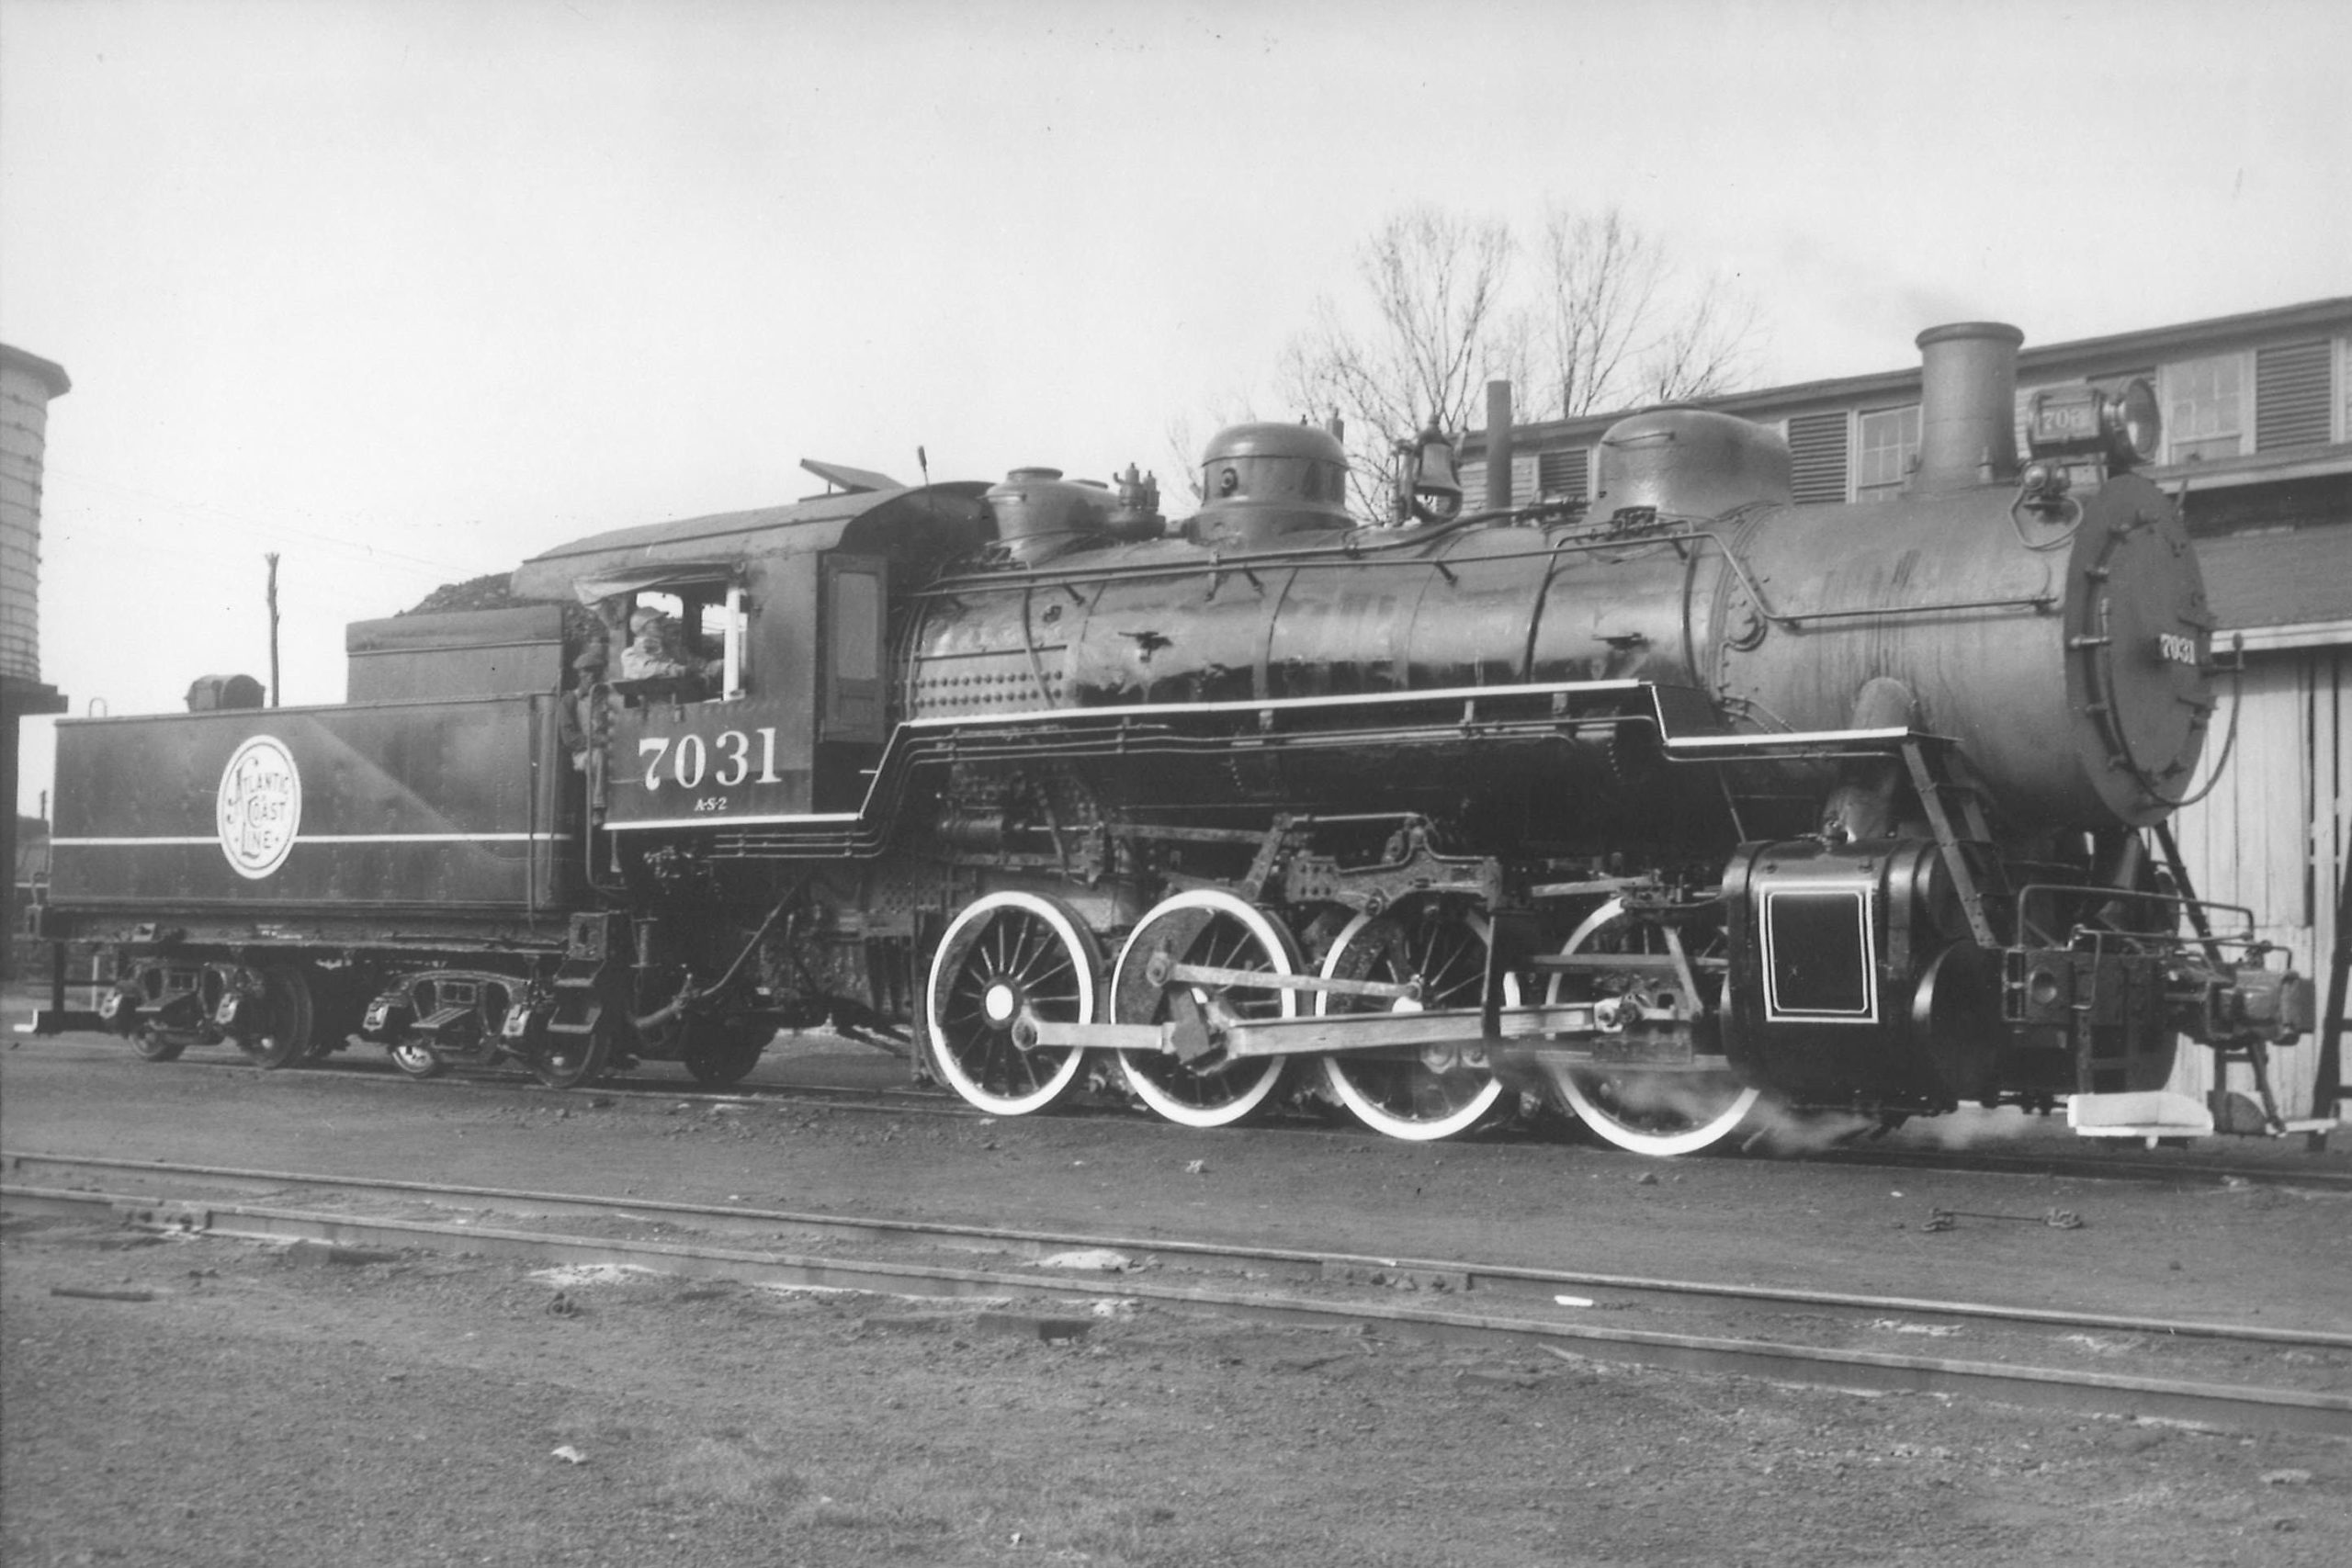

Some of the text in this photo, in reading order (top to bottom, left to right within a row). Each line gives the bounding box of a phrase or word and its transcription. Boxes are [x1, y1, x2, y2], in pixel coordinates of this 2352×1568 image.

[2160, 633, 2195, 665] 7031
[639, 728, 782, 791] 7031
[227, 756, 289, 808] ATLANTIC
[247, 795, 287, 828] COAST
[241, 818, 272, 860] LINE
